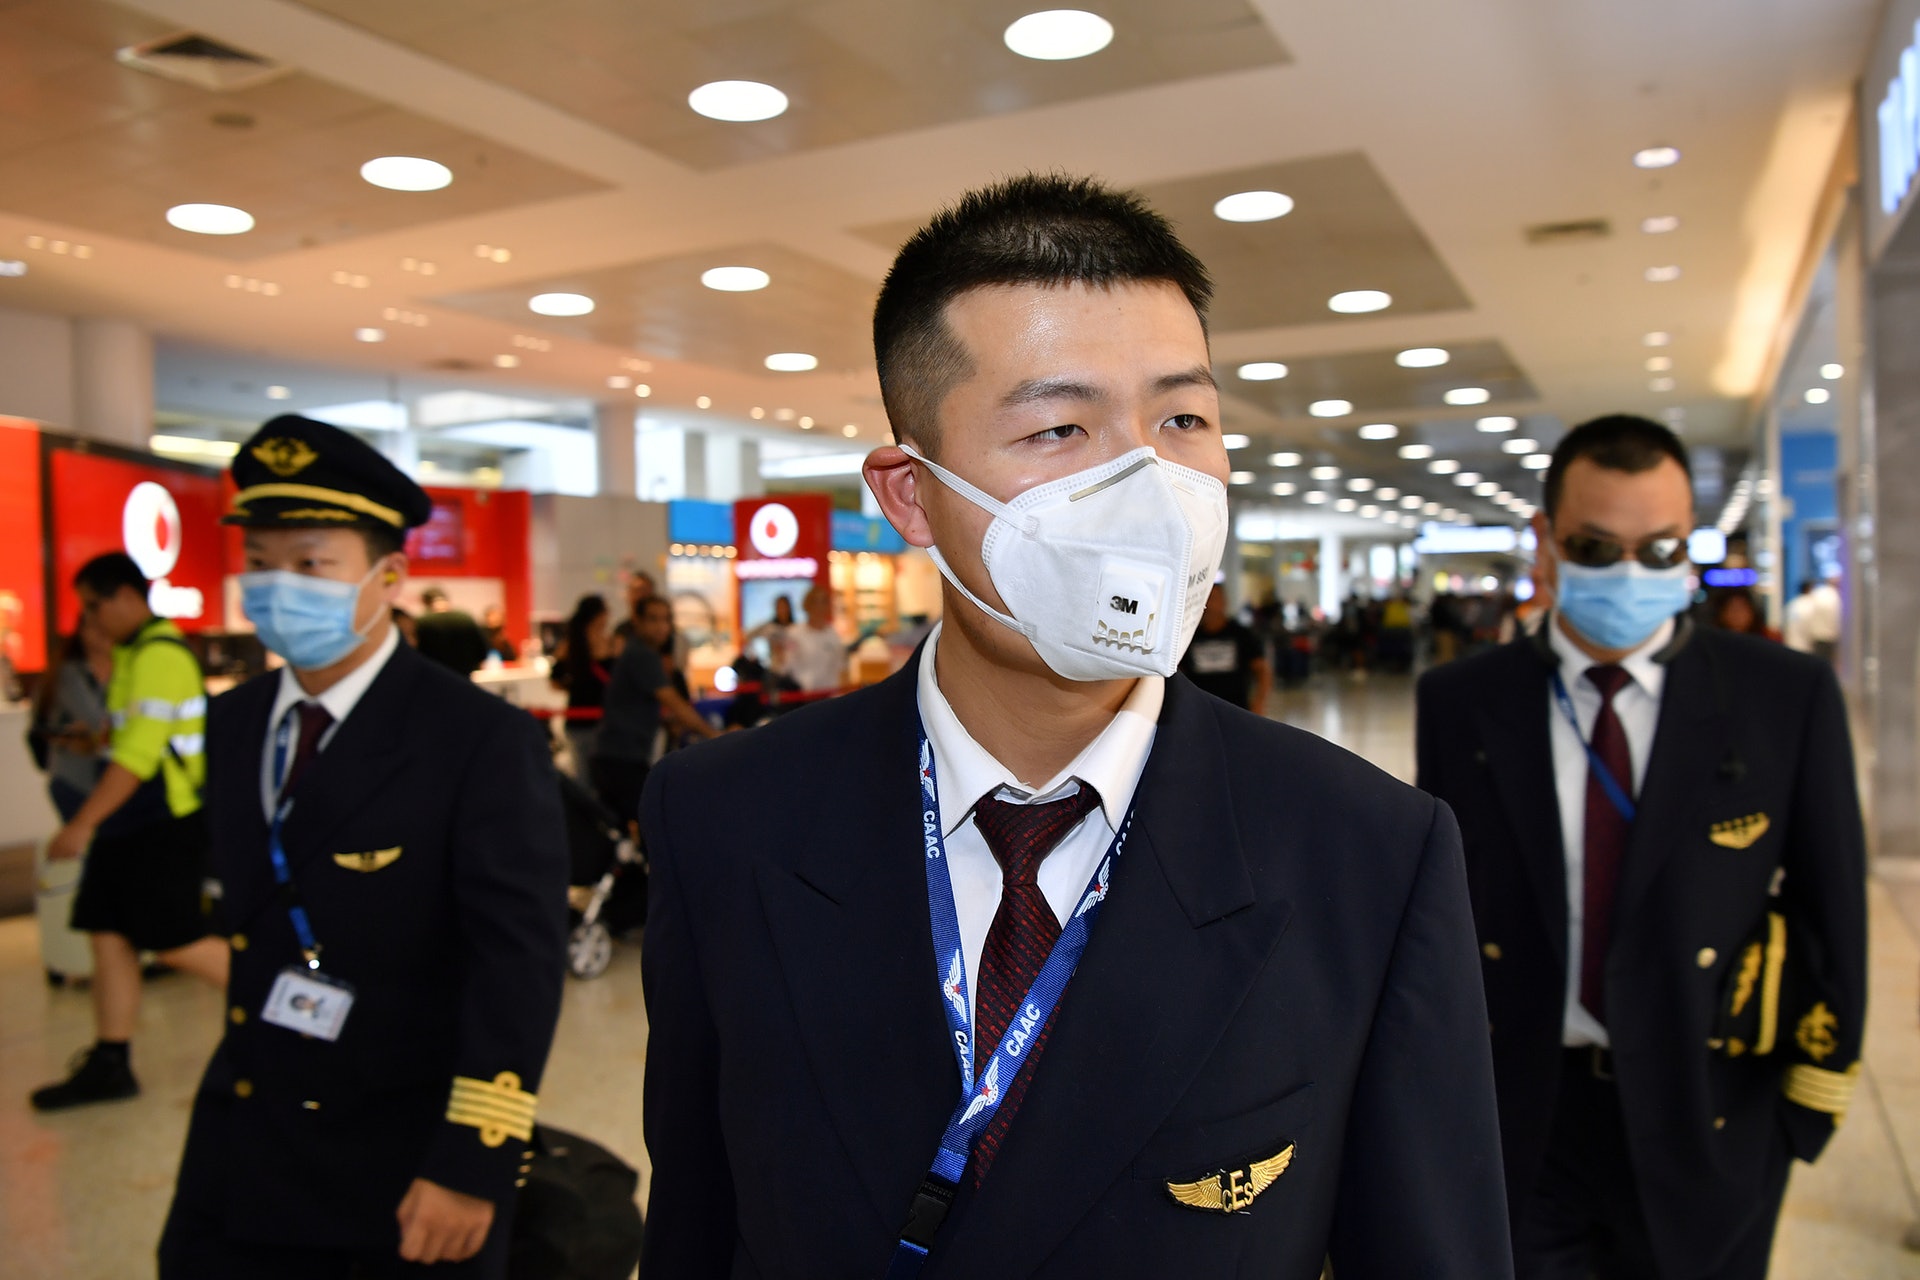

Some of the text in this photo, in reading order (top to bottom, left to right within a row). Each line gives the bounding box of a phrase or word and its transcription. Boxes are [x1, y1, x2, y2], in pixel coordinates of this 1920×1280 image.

[1110, 595, 1139, 615] 3M
[923, 810, 940, 859] CAAC
[1006, 1003, 1041, 1057] CAAC
[954, 1030, 972, 1081] CAAC
